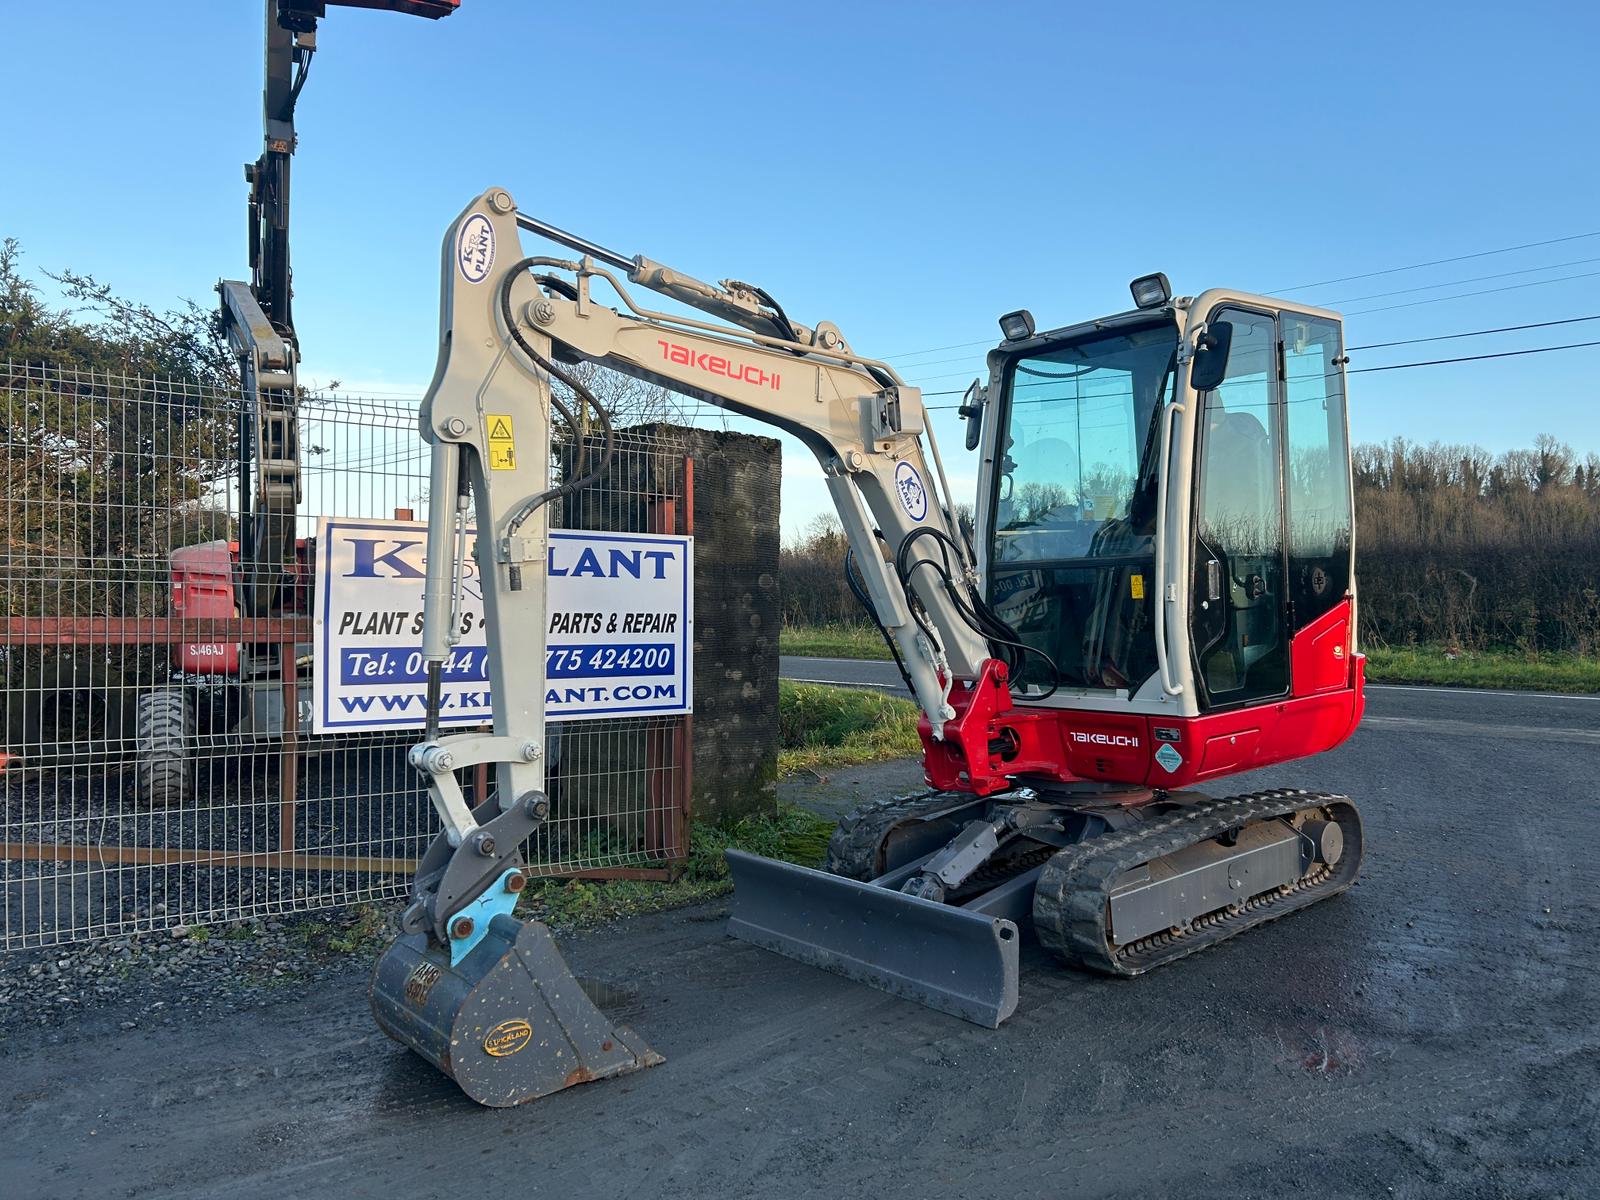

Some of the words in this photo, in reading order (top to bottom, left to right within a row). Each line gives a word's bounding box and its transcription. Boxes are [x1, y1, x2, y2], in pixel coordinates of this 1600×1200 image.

[475, 226, 490, 273] PLANT
[899, 480, 914, 509] PLANT
[548, 546, 676, 580] LANT
[338, 611, 408, 635] PLANT
[549, 612, 602, 634] PARTS
[606, 612, 617, 634] &
[622, 613, 677, 633] REPAIR
[348, 653, 396, 676] Tel:
[589, 648, 670, 670] 424200
